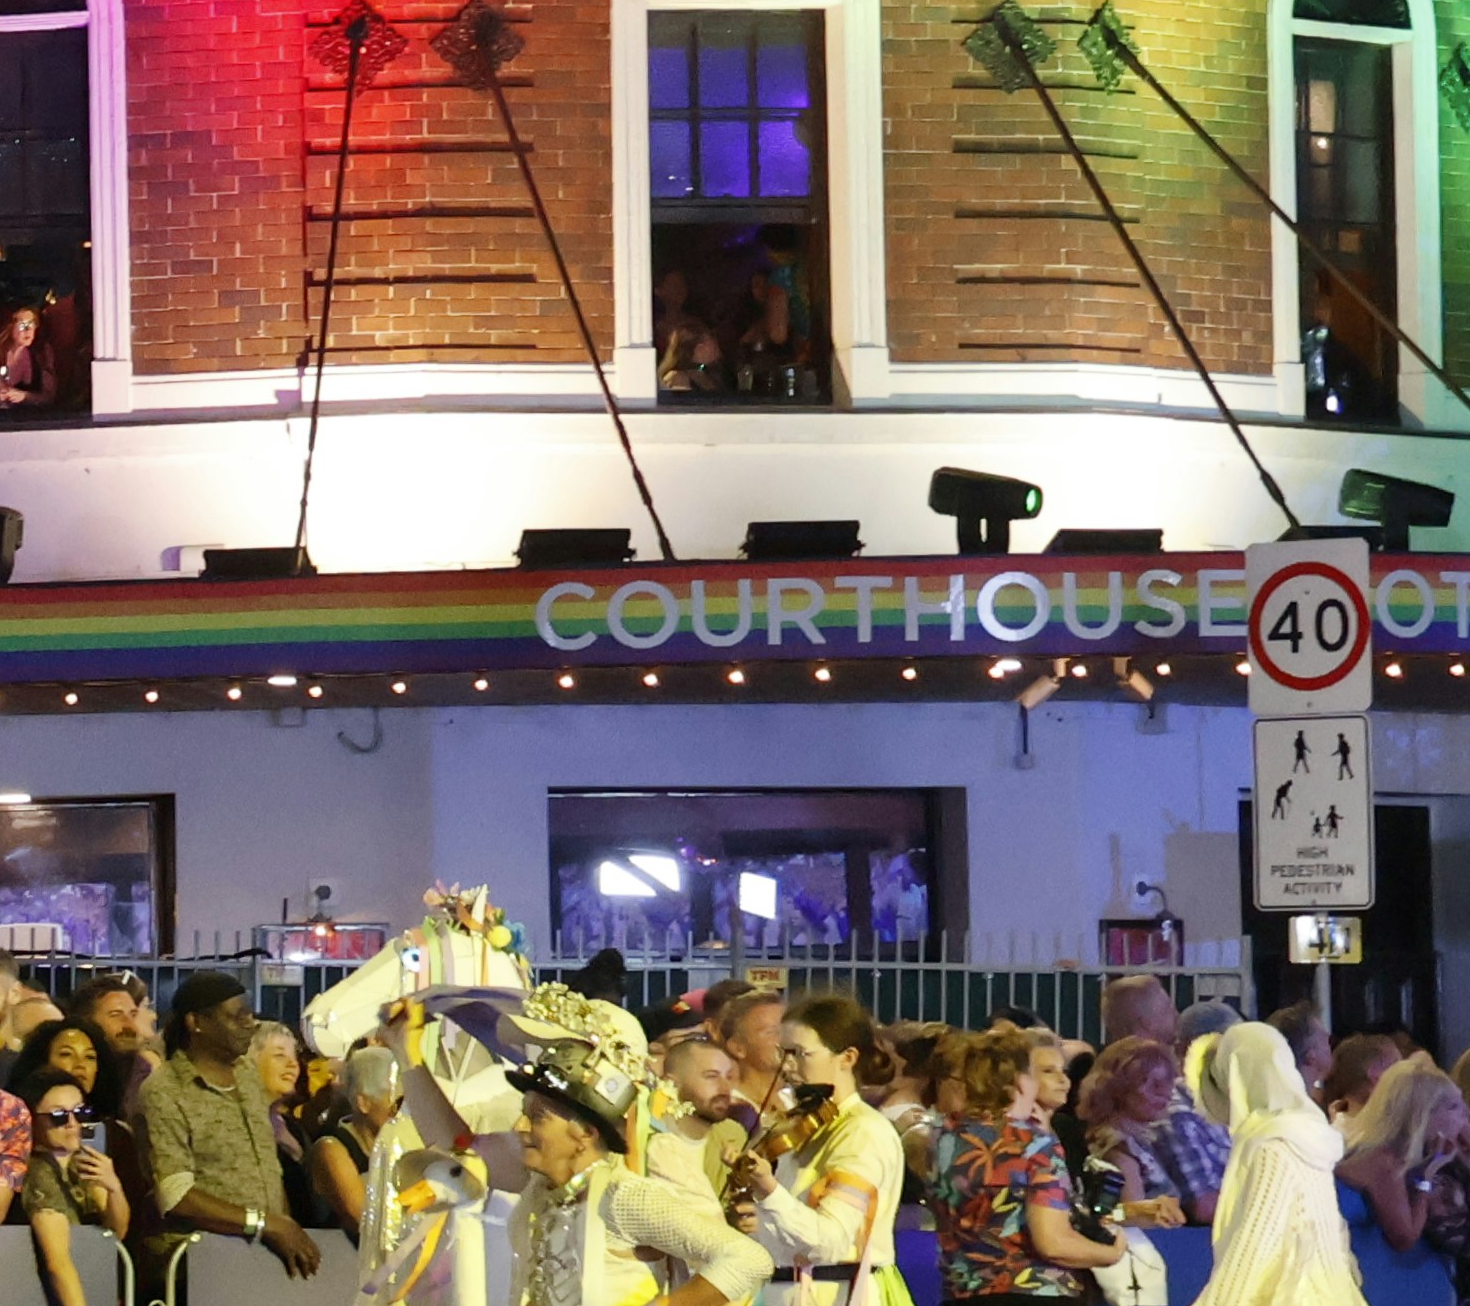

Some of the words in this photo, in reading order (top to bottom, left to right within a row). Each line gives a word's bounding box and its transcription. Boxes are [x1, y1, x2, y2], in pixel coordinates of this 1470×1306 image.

[532, 566, 1246, 652] COURTHOUSE
[1376, 569, 1470, 639] OT
[1268, 598, 1350, 653] 40
[1296, 846, 1329, 858] HIGH
[1270, 863, 1355, 878] PEDESTRIAN
[1283, 880, 1343, 895] ACTIVITY
